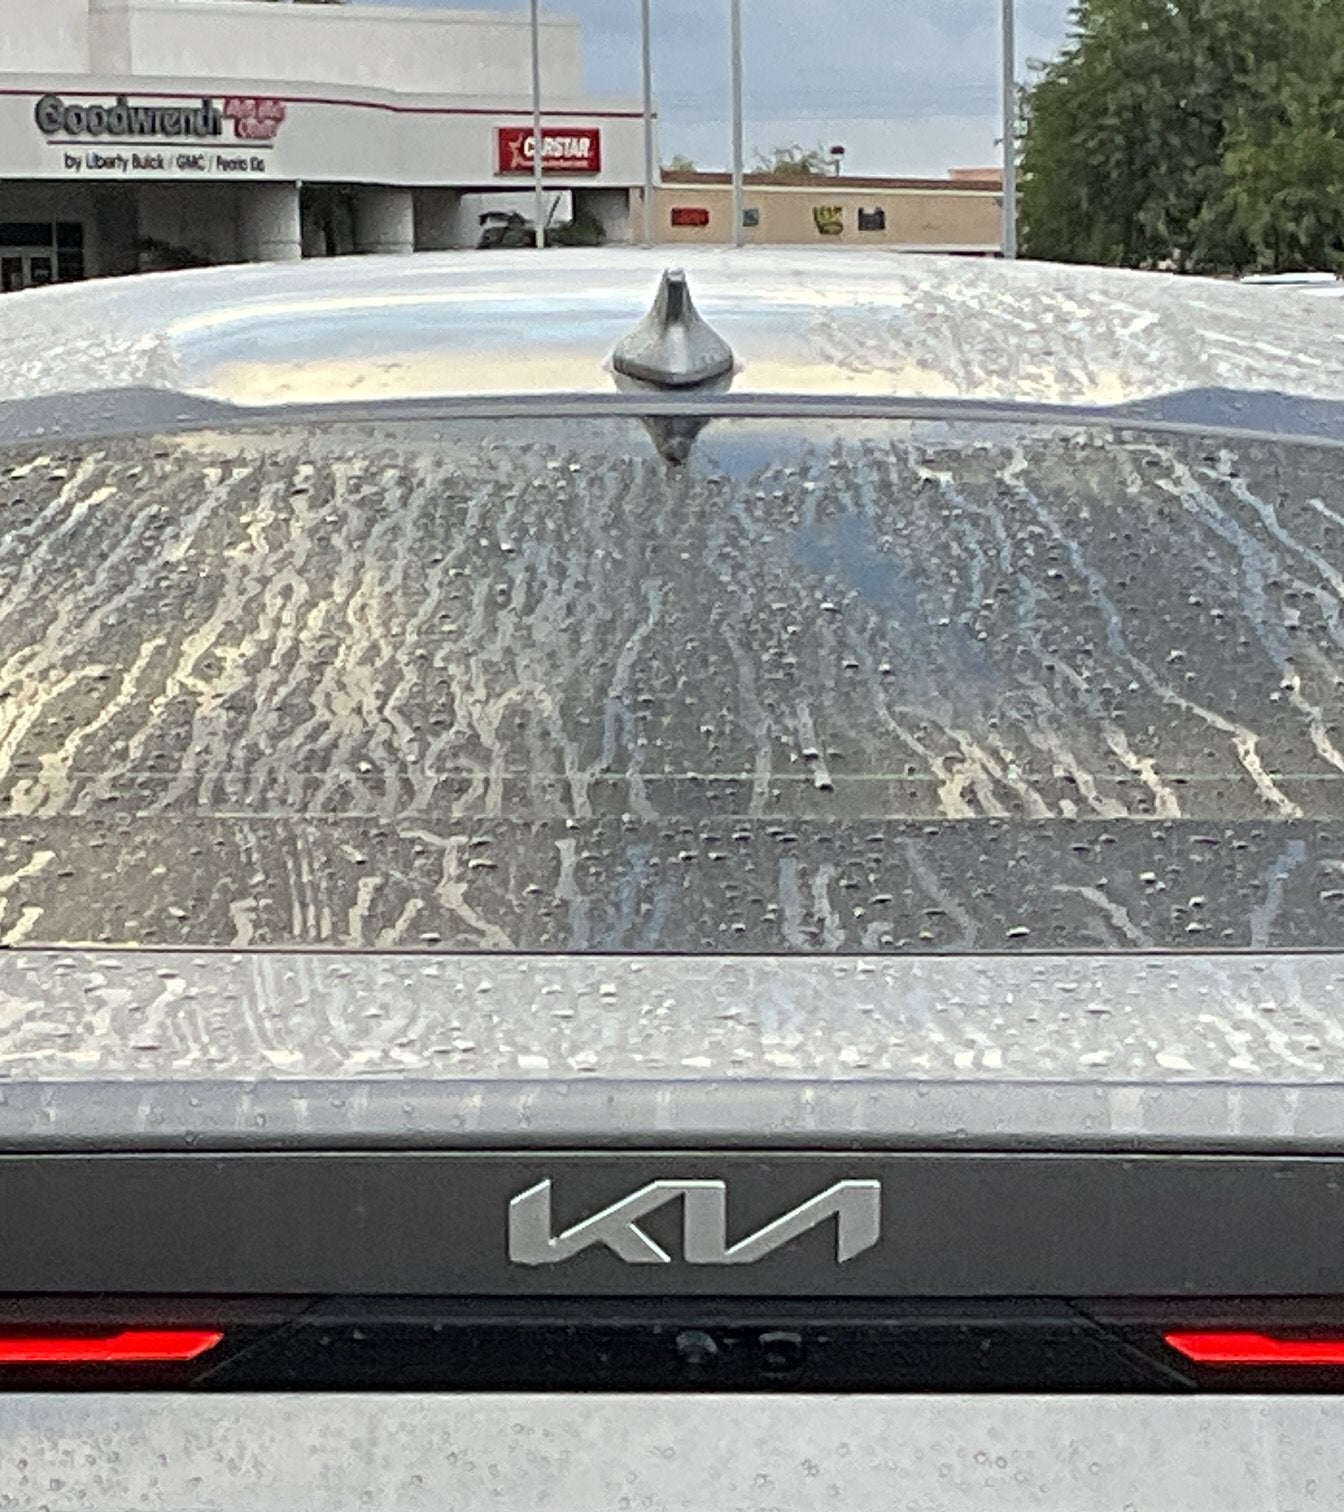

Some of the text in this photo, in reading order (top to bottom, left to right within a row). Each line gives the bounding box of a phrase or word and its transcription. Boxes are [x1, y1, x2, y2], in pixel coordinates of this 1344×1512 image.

[35, 93, 222, 136] Goodwrench
[64, 152, 82, 173] by
[86, 152, 129, 173] Liberty
[132, 153, 164, 170] Buick
[523, 136, 591, 158] CRSTAR
[509, 1178, 881, 1264] KIA
